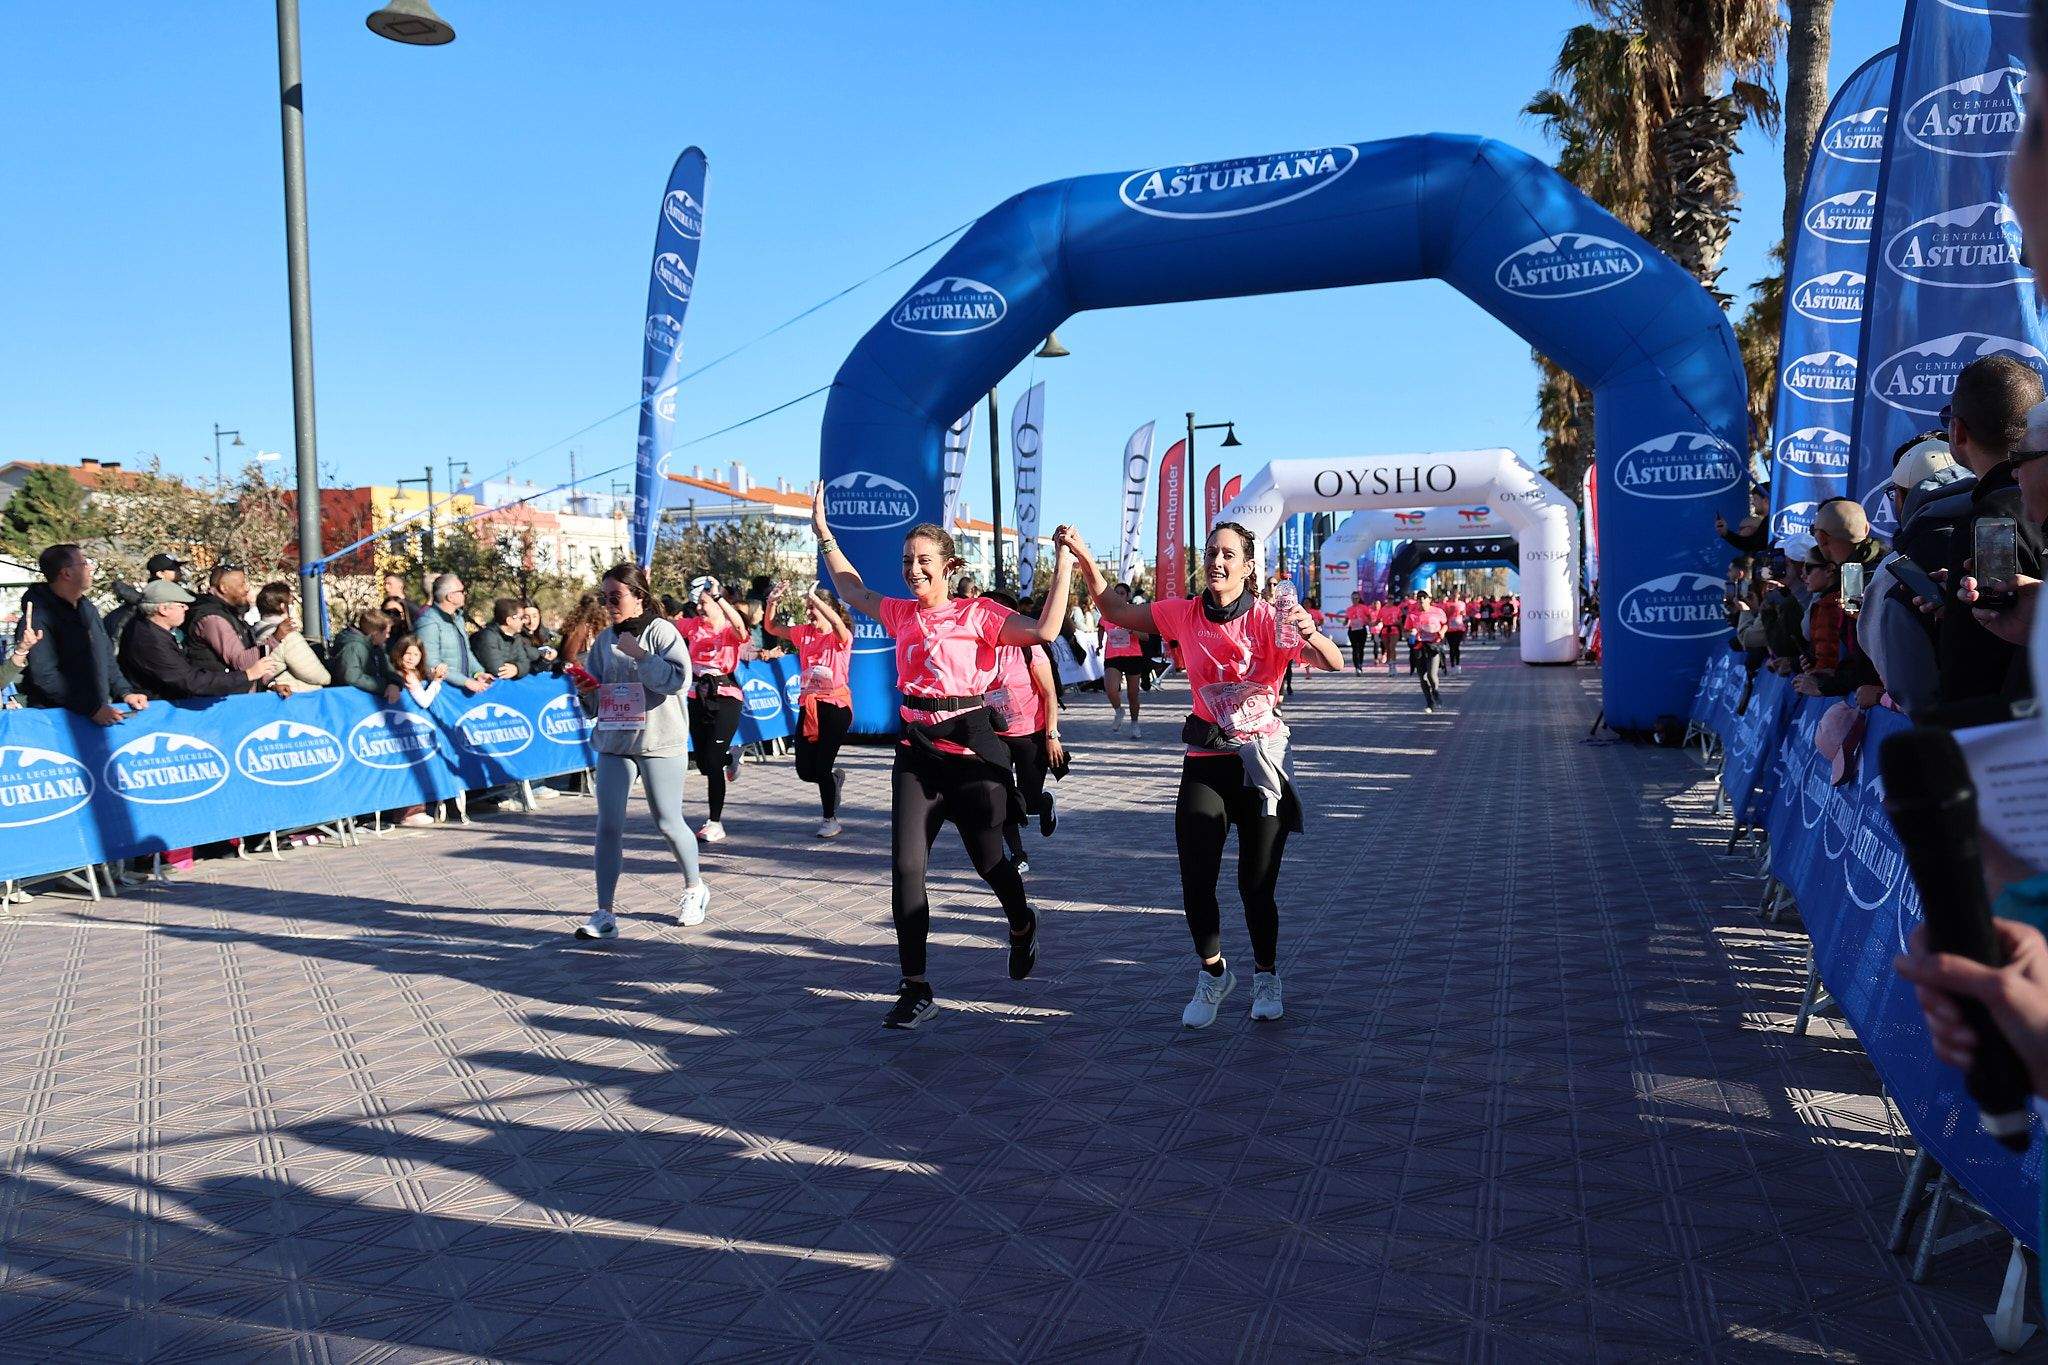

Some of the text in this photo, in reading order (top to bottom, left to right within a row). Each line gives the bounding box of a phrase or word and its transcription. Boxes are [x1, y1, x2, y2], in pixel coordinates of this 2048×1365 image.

[1953, 98, 2012, 110] CENTRAL
[1916, 103, 2026, 137] ASTURI
[1828, 128, 1883, 149] ASTUR
[1135, 152, 1339, 202] ASTURIANA
[1812, 208, 1873, 230] ASTURI
[1932, 231, 1994, 242] CENTRAL
[1898, 236, 2021, 268] ASTURIA
[1507, 257, 1634, 288] ASTURIANA
[1799, 288, 1863, 310] ASTURIA
[896, 303, 998, 323] ASTURIANA
[1915, 361, 1966, 371] CENTRA
[1790, 367, 1856, 391] ASTURIA
[1783, 442, 1850, 467] ASTURIAN
[1313, 463, 1457, 498] OYSHO
[1623, 460, 1737, 486] ASTURIANA
[1166, 463, 1178, 541] Santander
[1500, 490, 1546, 502] OYSHO
[1232, 503, 1274, 515] OYSHO
[1428, 544, 1501, 554] VOLVO
[1527, 609, 1570, 620] OYSHO
[1626, 598, 1730, 623] ASTURIAN
[462, 725, 531, 746] ASTURIANA
[129, 756, 173, 767] CENTRAL
[247, 745, 339, 774] ASTURIANA
[26, 766, 78, 780] LECHERA
[117, 760, 223, 791] ASTURIANA
[0, 776, 88, 807] URIANA
